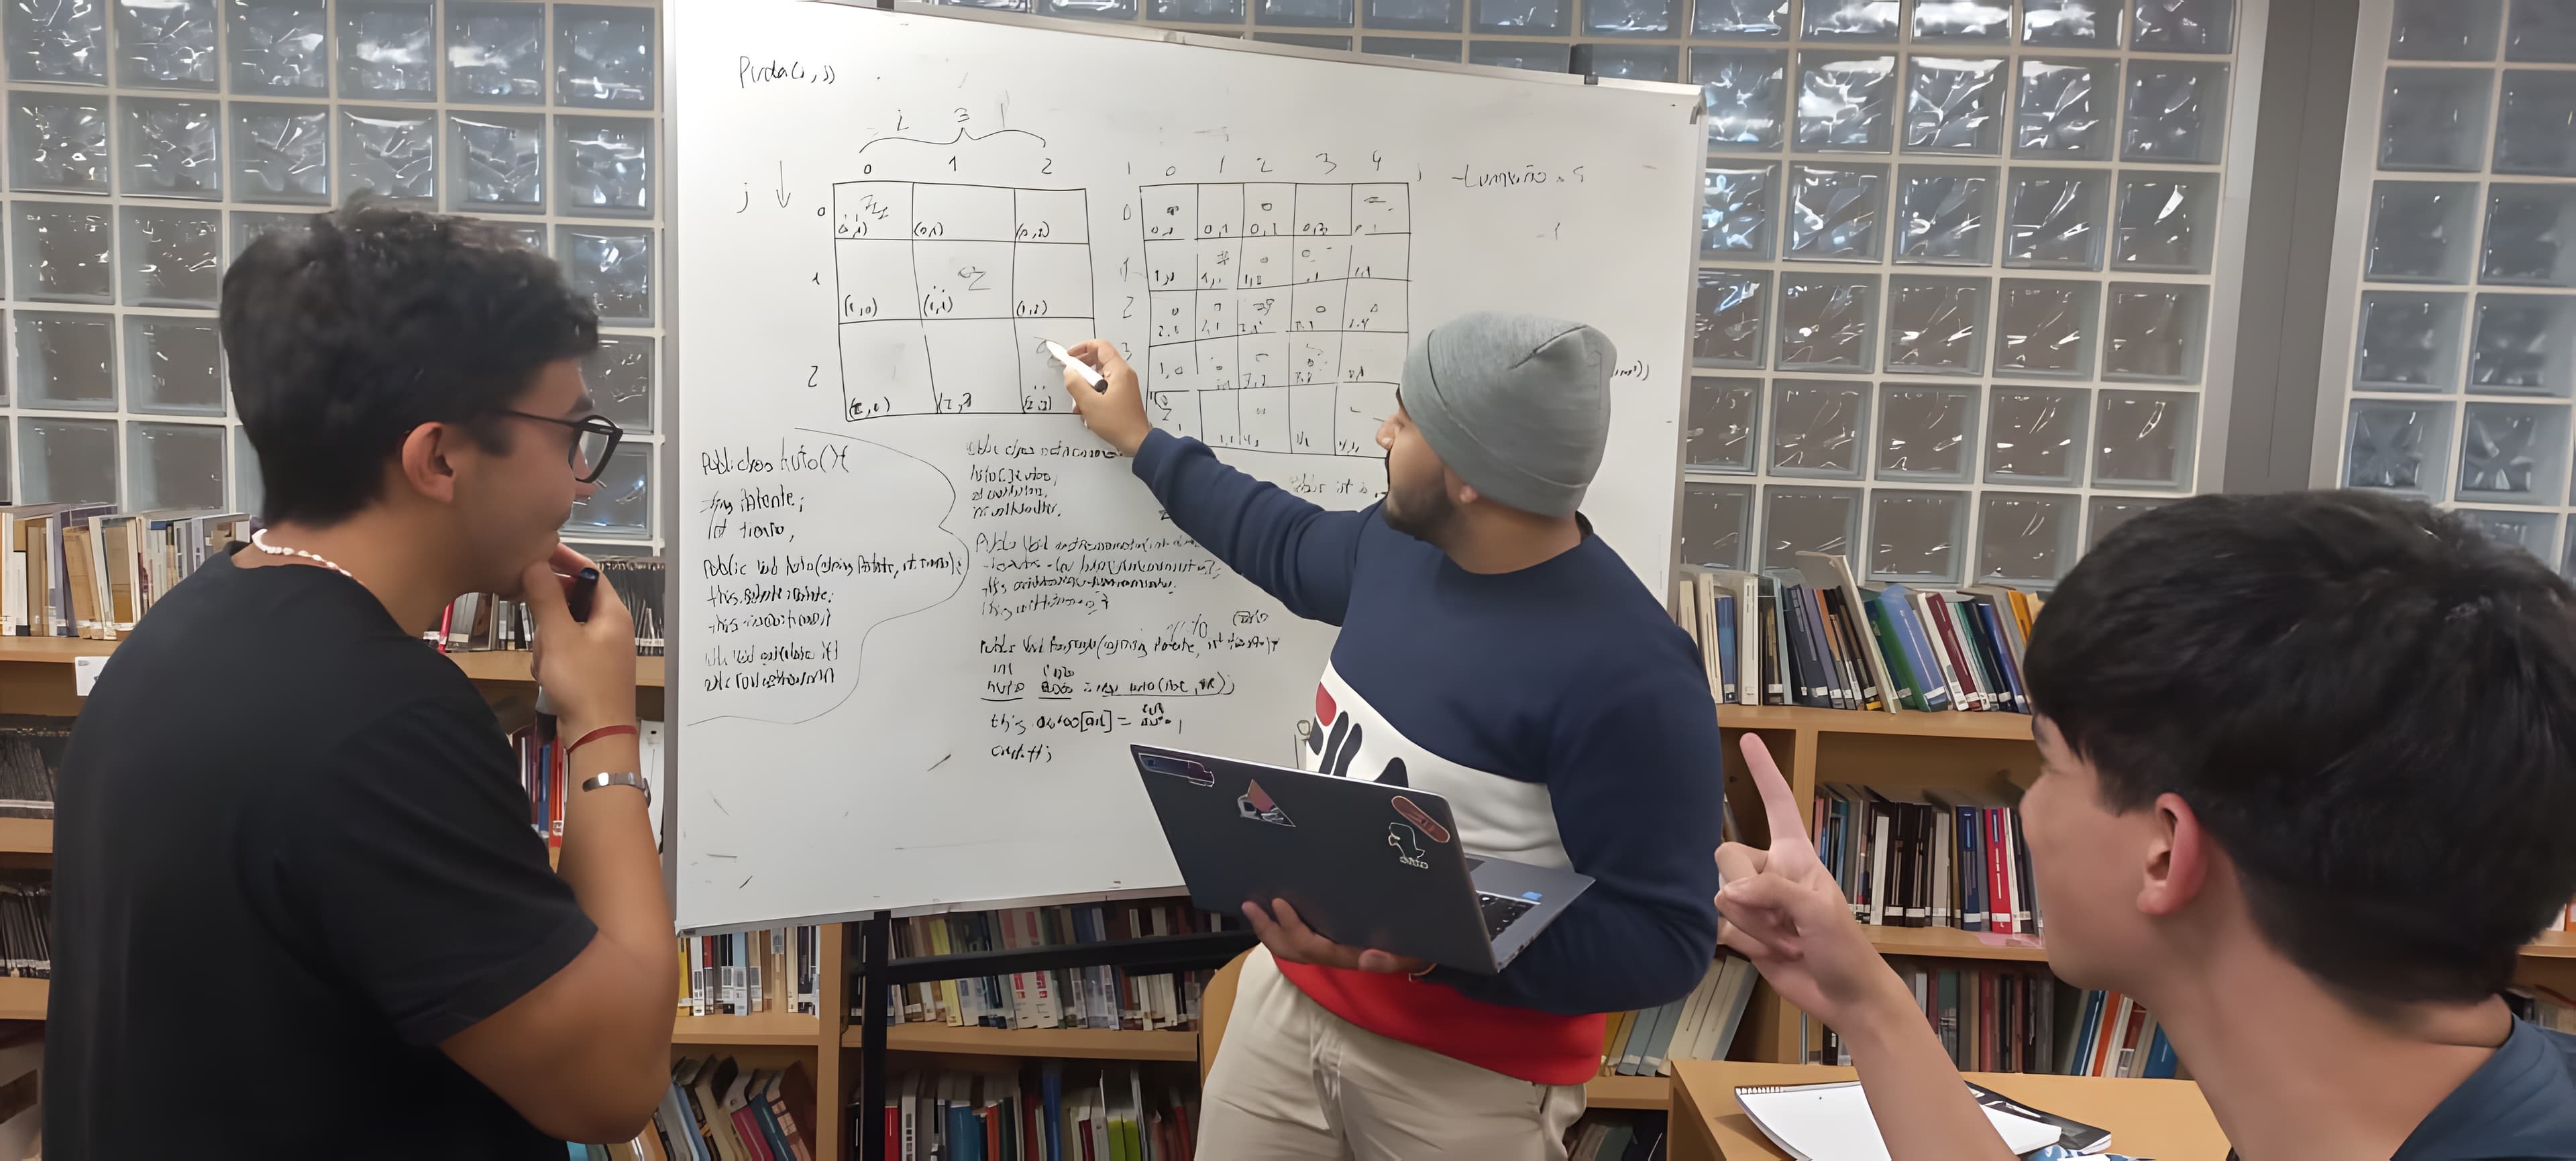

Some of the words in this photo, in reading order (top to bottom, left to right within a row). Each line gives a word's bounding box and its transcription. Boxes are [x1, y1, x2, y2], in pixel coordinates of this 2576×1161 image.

[1040, 158, 1053, 174] 2
[1256, 156, 1274, 173] 2
[1316, 152, 1337, 175] 3
